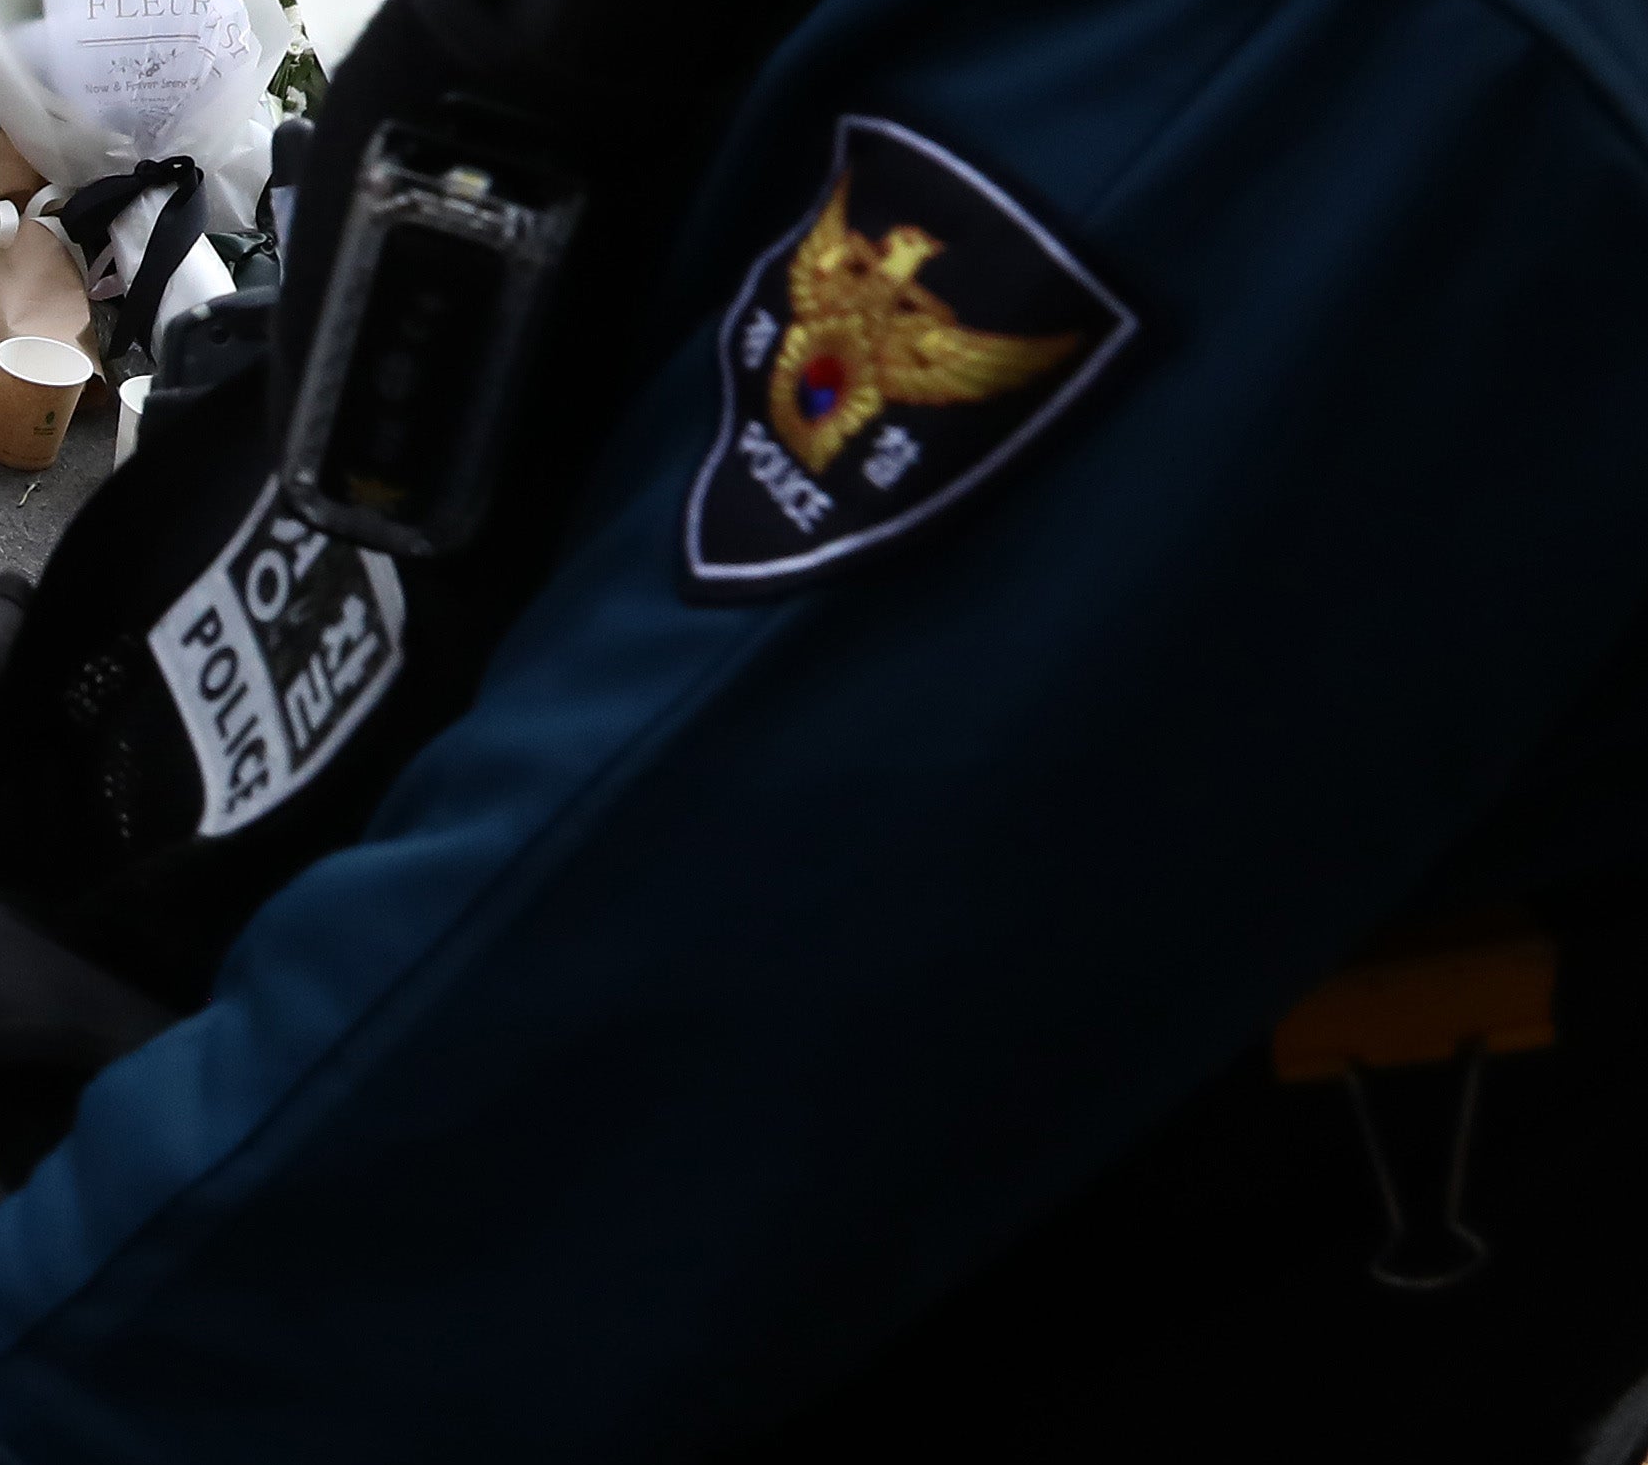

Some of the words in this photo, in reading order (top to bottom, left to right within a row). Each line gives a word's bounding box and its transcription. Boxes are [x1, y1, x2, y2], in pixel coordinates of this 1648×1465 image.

[85, 83, 110, 94] Now
[737, 420, 835, 536] POLICE
[180, 601, 271, 816] POLICE
